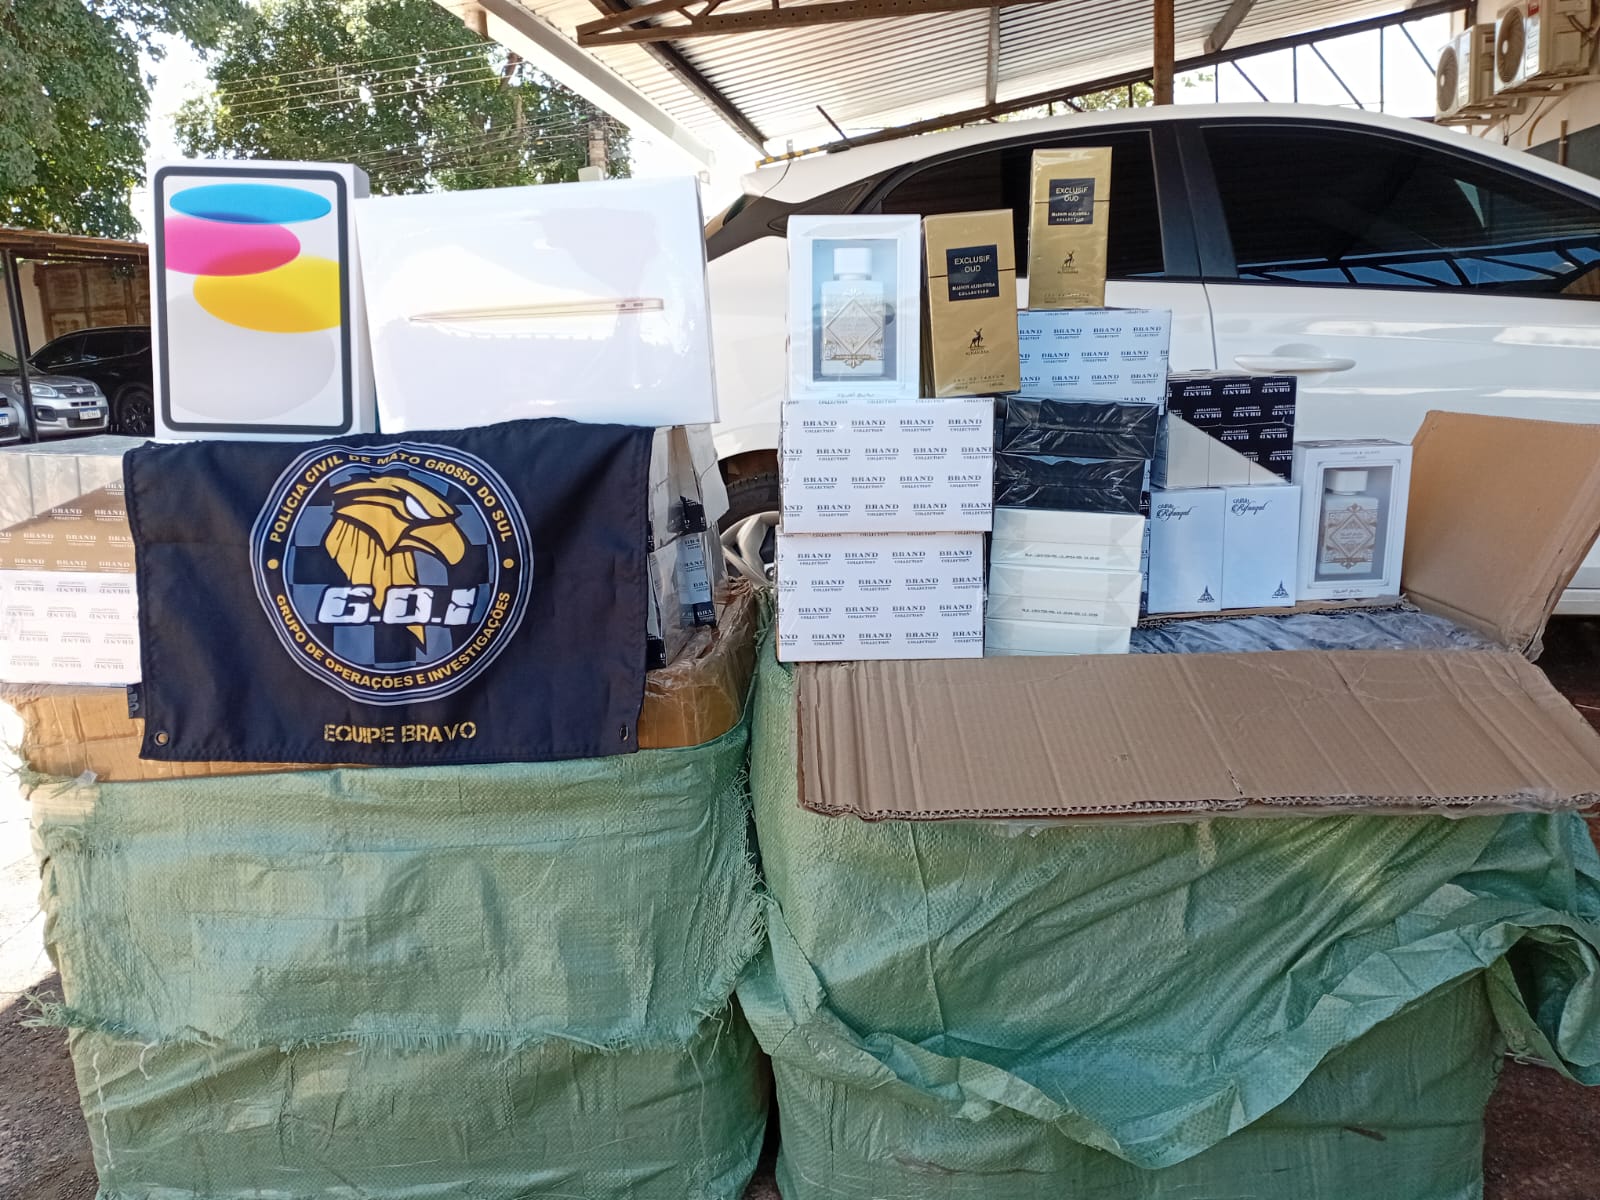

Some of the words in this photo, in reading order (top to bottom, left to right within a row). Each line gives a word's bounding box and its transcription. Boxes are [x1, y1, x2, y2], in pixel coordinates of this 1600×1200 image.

[1056, 186, 1088, 195] EXCLUSIF
[954, 254, 990, 265] EXCLUSIF
[964, 264, 981, 273] OUD
[1262, 386, 1290, 394] BRAND
[803, 419, 837, 427] BRAND
[851, 419, 886, 427] BRAND
[900, 418, 934, 426] BRAND
[948, 418, 982, 426] BRAND
[1220, 433, 1249, 441] BRAND
[816, 447, 851, 455] BRAND
[913, 446, 947, 454] BRAND
[851, 475, 886, 483] BRAND
[948, 474, 982, 482] BRAND
[269, 484, 308, 543] POLÍCIA
[305, 455, 343, 483] CIVIL
[348, 454, 371, 464] DE
[376, 453, 420, 465] MATO
[424, 459, 478, 486] GROSSO
[477, 486, 496, 507] DO
[492, 509, 512, 542] SUL
[865, 503, 899, 511] BRAND
[913, 502, 947, 510] BRAND
[845, 605, 879, 613] BRAND
[892, 604, 926, 612] BRAND
[276, 594, 307, 643] GRUPO
[304, 642, 324, 661] DE
[325, 658, 413, 690] OPERAÇÕES
[416, 673, 426, 685] E
[428, 592, 511, 682] INVESTIGAÇÕES
[324, 724, 396, 744] EQUIPE
[401, 721, 477, 743] BRAVO
